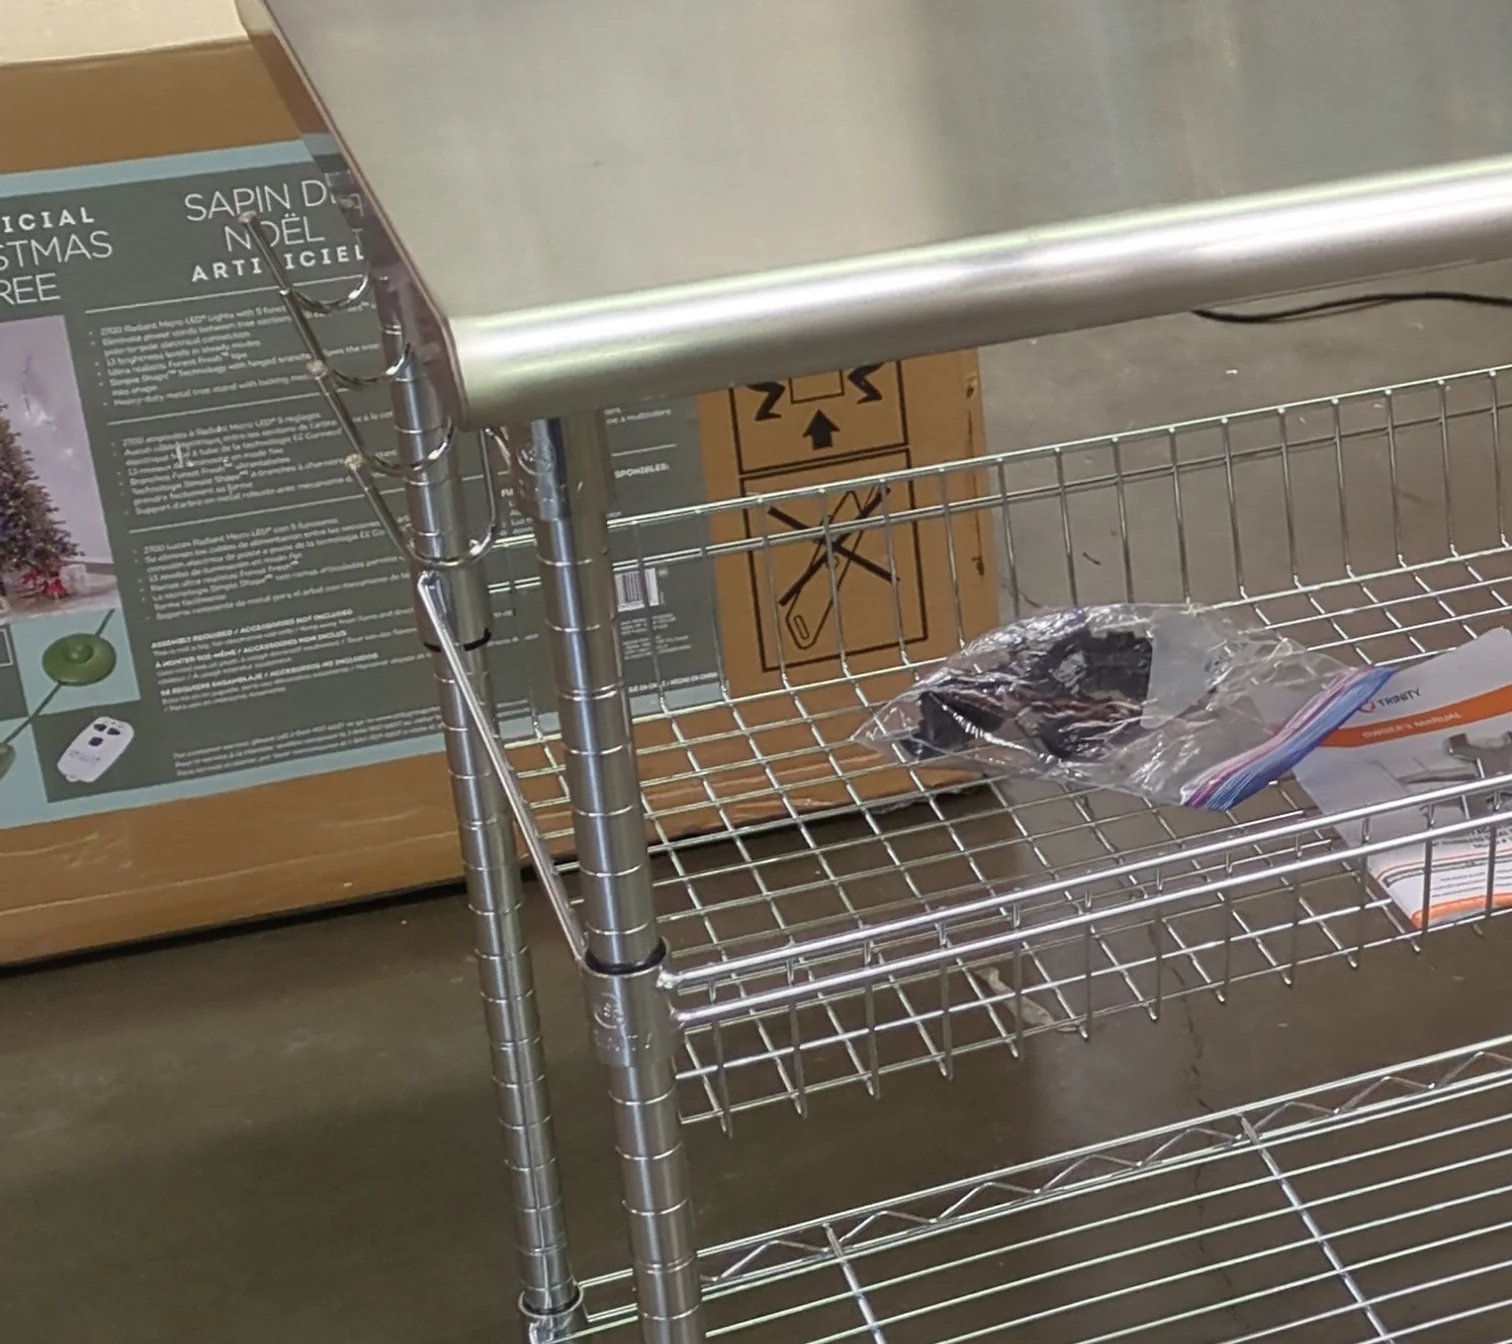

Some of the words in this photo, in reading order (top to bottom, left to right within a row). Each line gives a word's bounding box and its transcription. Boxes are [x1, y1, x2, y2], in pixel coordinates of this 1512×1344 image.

[184, 183, 292, 222] SAPIN
[302, 178, 337, 207] D
[191, 244, 364, 282] ARTIICIEL
[1378, 687, 1421, 708] TRINITY
[1362, 722, 1412, 739] OWNER'S
[1413, 711, 1462, 728] MANUAL
